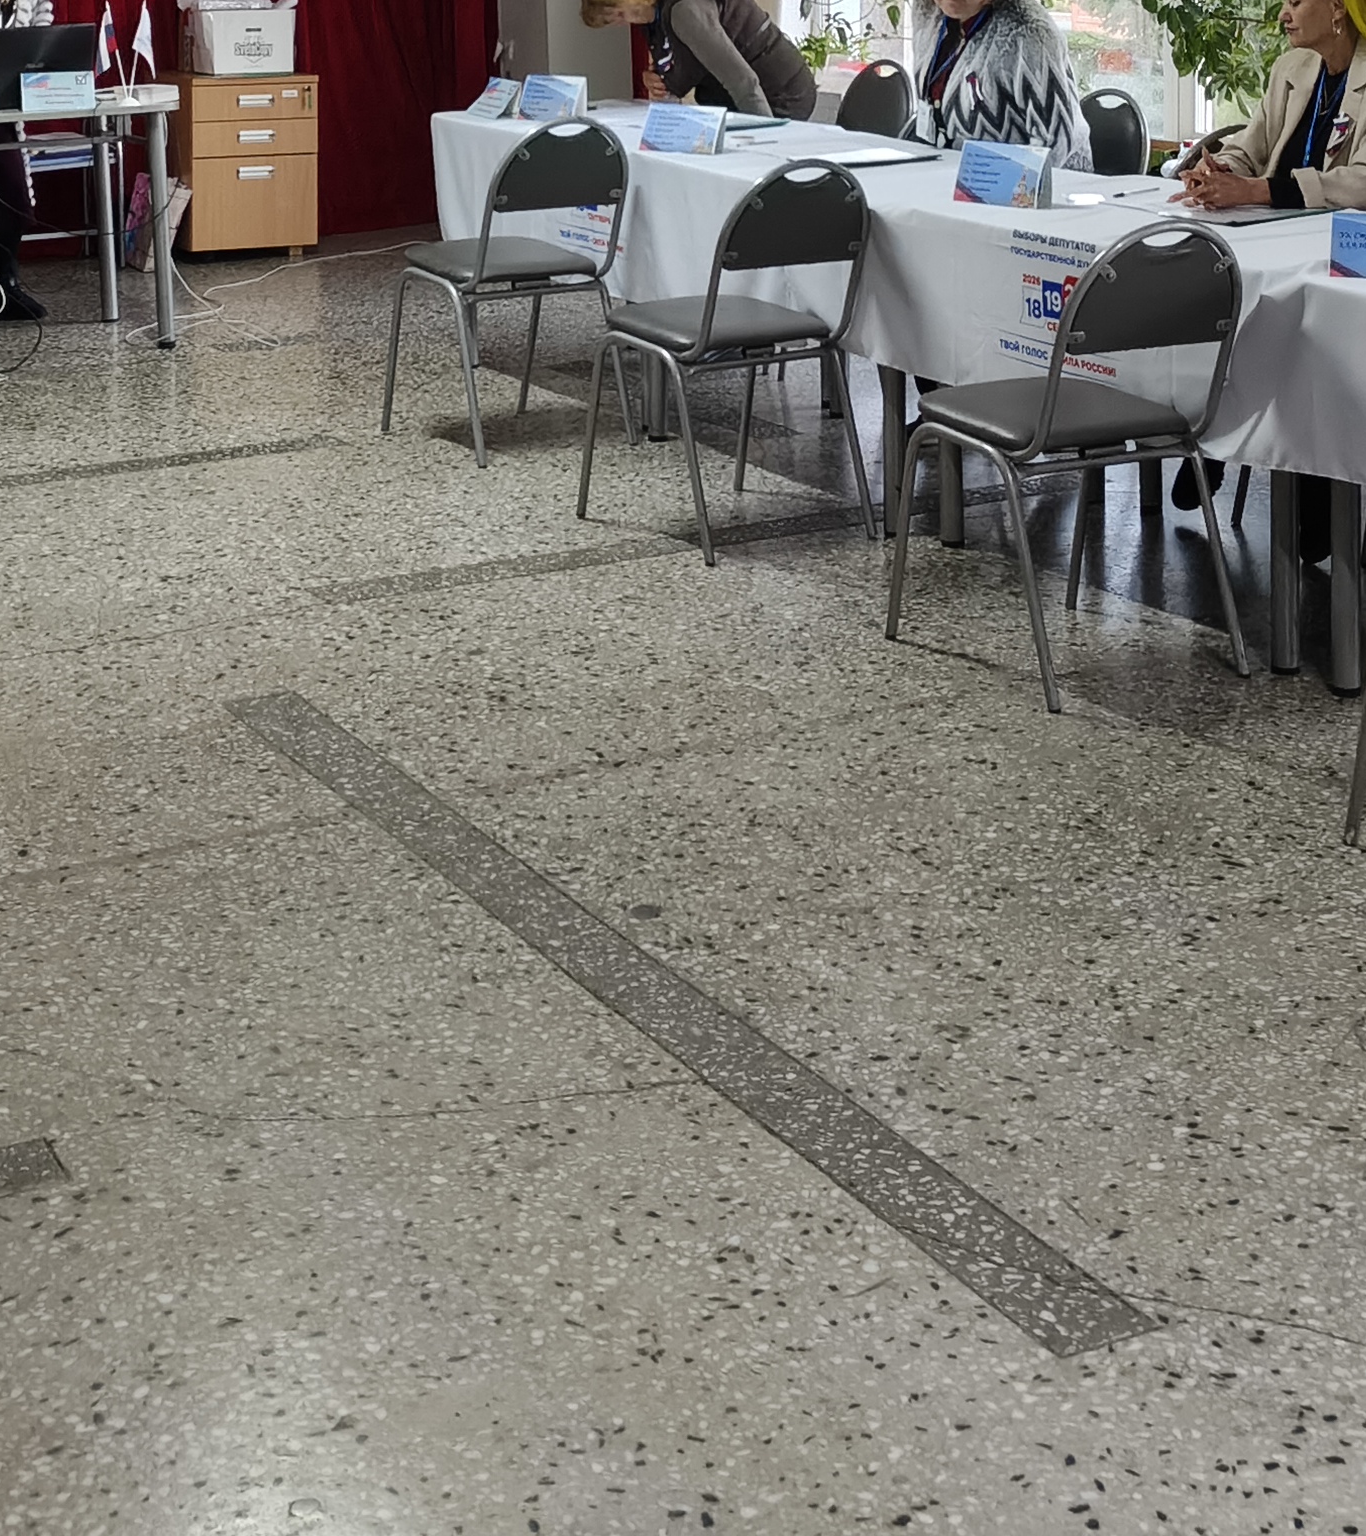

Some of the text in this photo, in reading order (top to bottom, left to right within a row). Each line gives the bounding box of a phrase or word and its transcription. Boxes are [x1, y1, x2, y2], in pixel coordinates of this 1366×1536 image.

[1012, 229, 1096, 253] ВЫБОРЫ ДЕПУТАТОВ
[1010, 246, 1076, 266] ГОСУДАРСТВЕННОЙ
[1025, 297, 1042, 319] 18
[1044, 290, 1062, 312] 19
[999, 339, 1117, 378] ТВОЙ ГОЛОС ИЛА РОССИИ!
